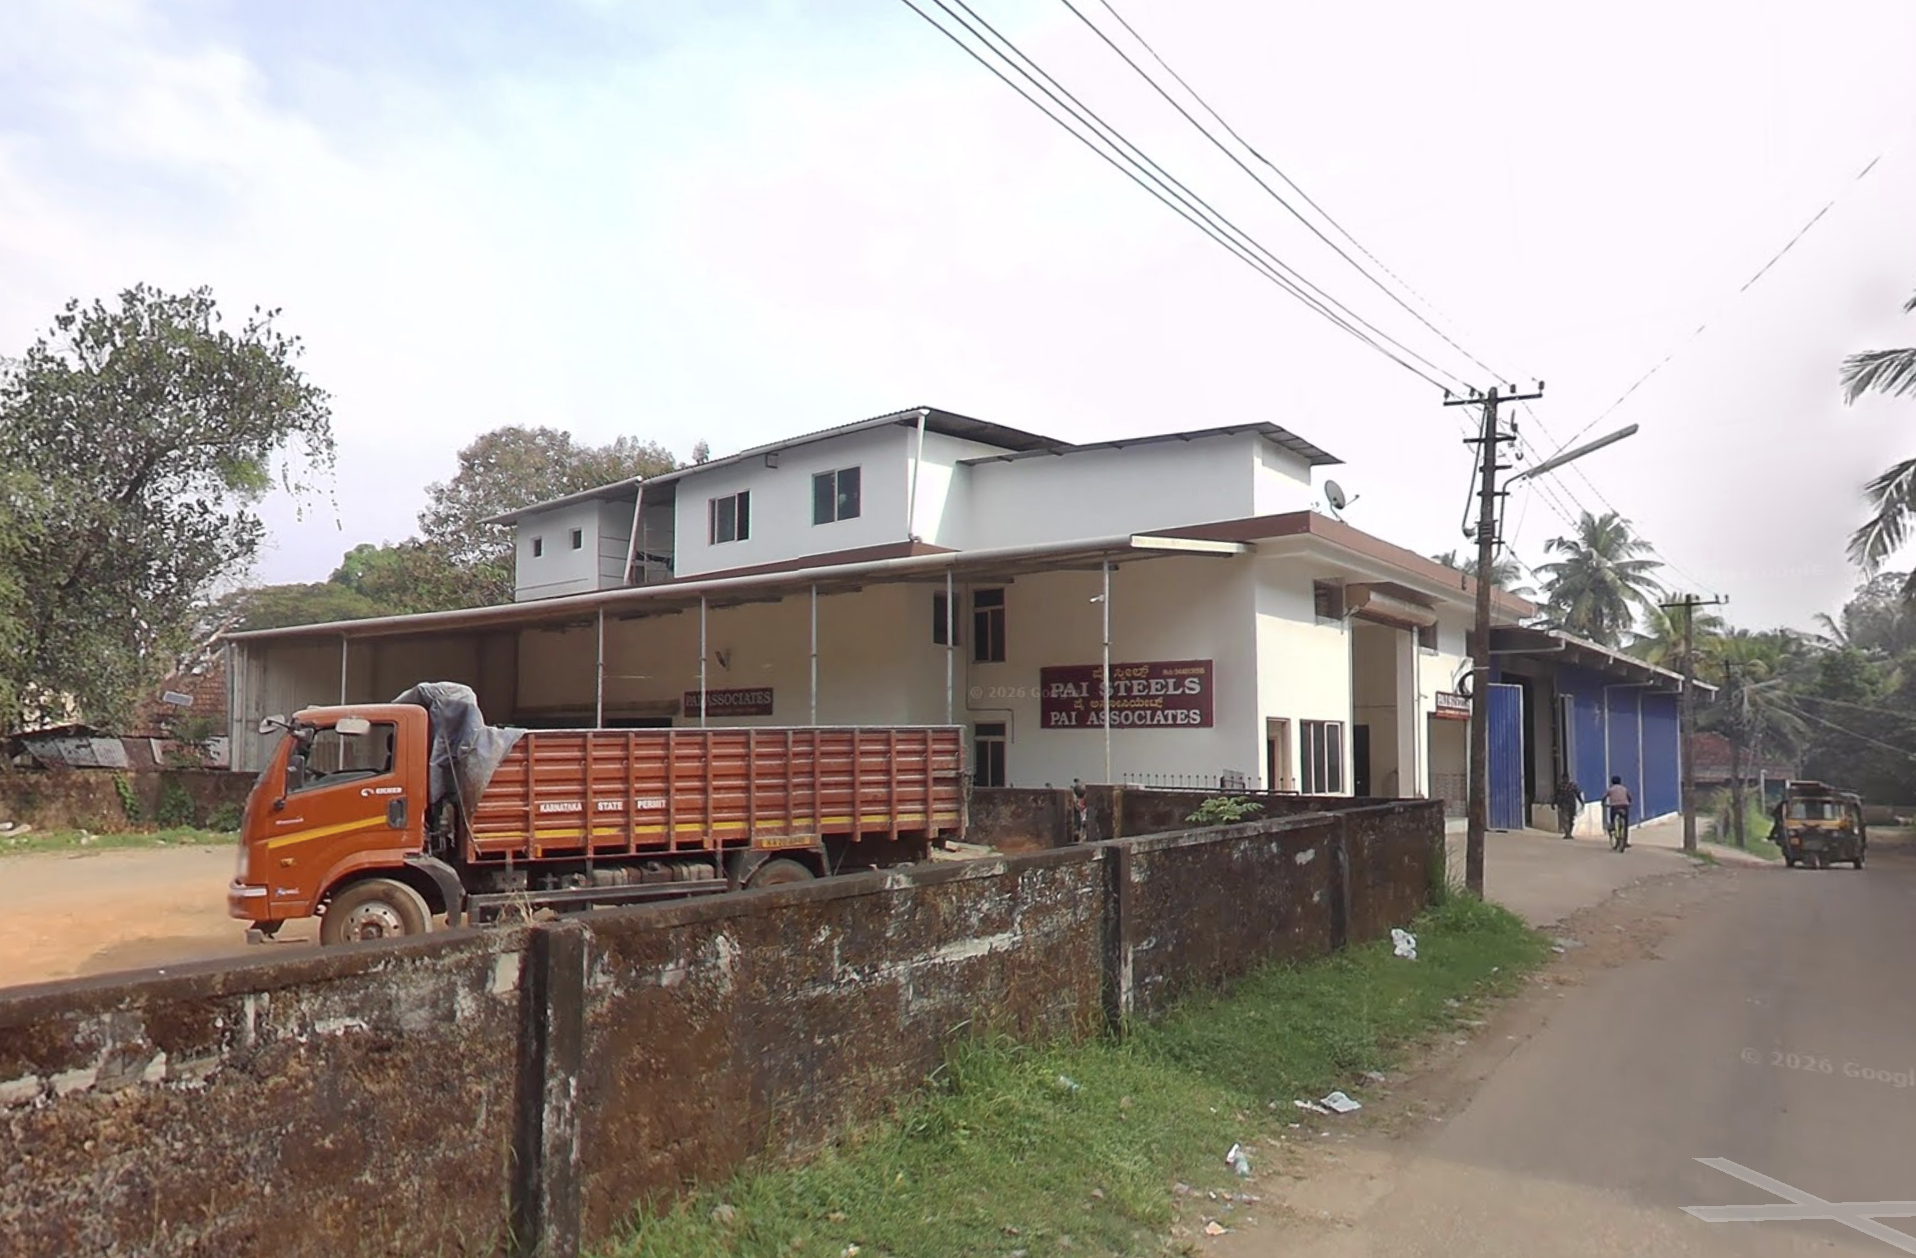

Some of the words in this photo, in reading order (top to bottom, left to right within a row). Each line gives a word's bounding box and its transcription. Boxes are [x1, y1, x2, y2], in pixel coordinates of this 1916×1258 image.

[1050, 681, 1090, 698] PAI
[1099, 677, 1201, 697] STEELS
[1050, 711, 1078, 725] PAI
[1087, 709, 1201, 725] ASSOCIATES
[540, 802, 583, 813] KARNATAKA
[597, 801, 623, 811] STATE
[637, 799, 667, 810] PERMIT
